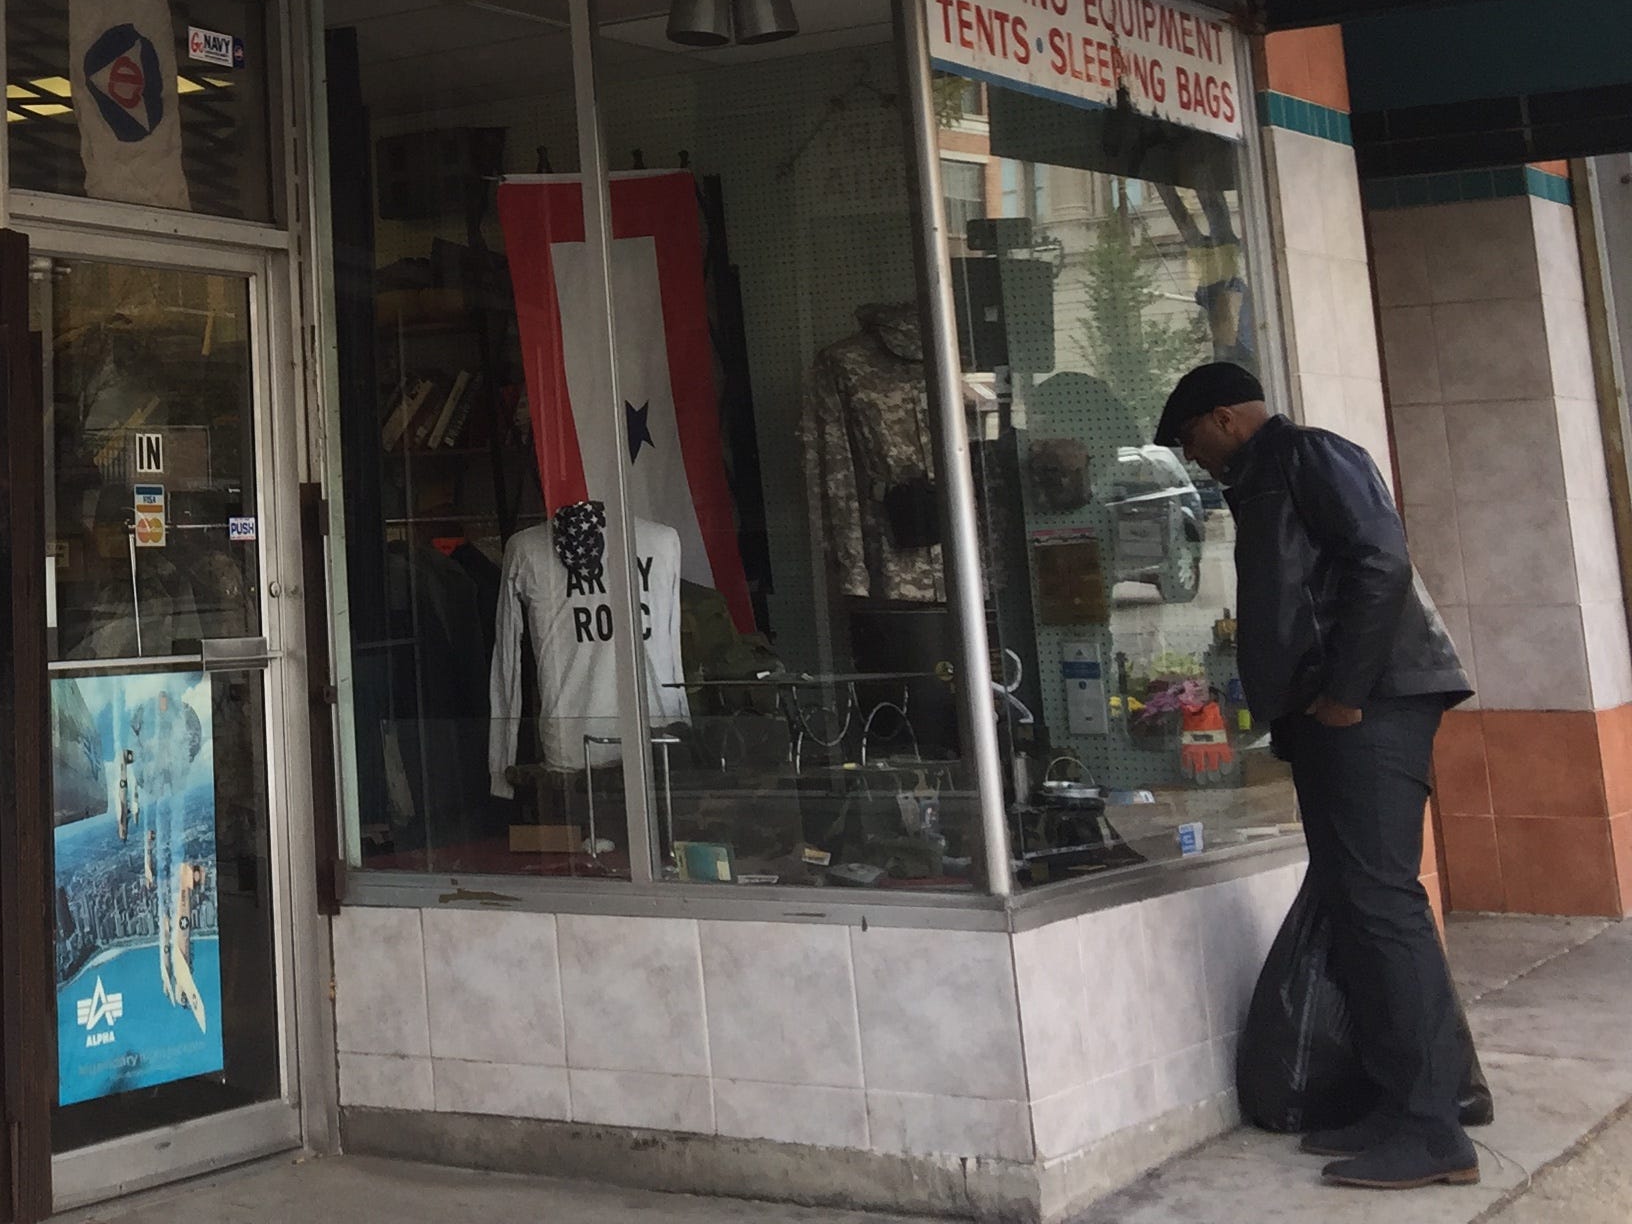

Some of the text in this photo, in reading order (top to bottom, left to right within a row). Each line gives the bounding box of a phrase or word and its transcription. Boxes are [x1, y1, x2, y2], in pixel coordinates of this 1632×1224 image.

[204, 34, 231, 54] NAVY
[1175, 66, 1235, 124] BAGS
[138, 436, 161, 470] IN
[230, 522, 254, 535] PUSH
[566, 557, 653, 598] ARY
[86, 1031, 116, 1048] ALPHA
